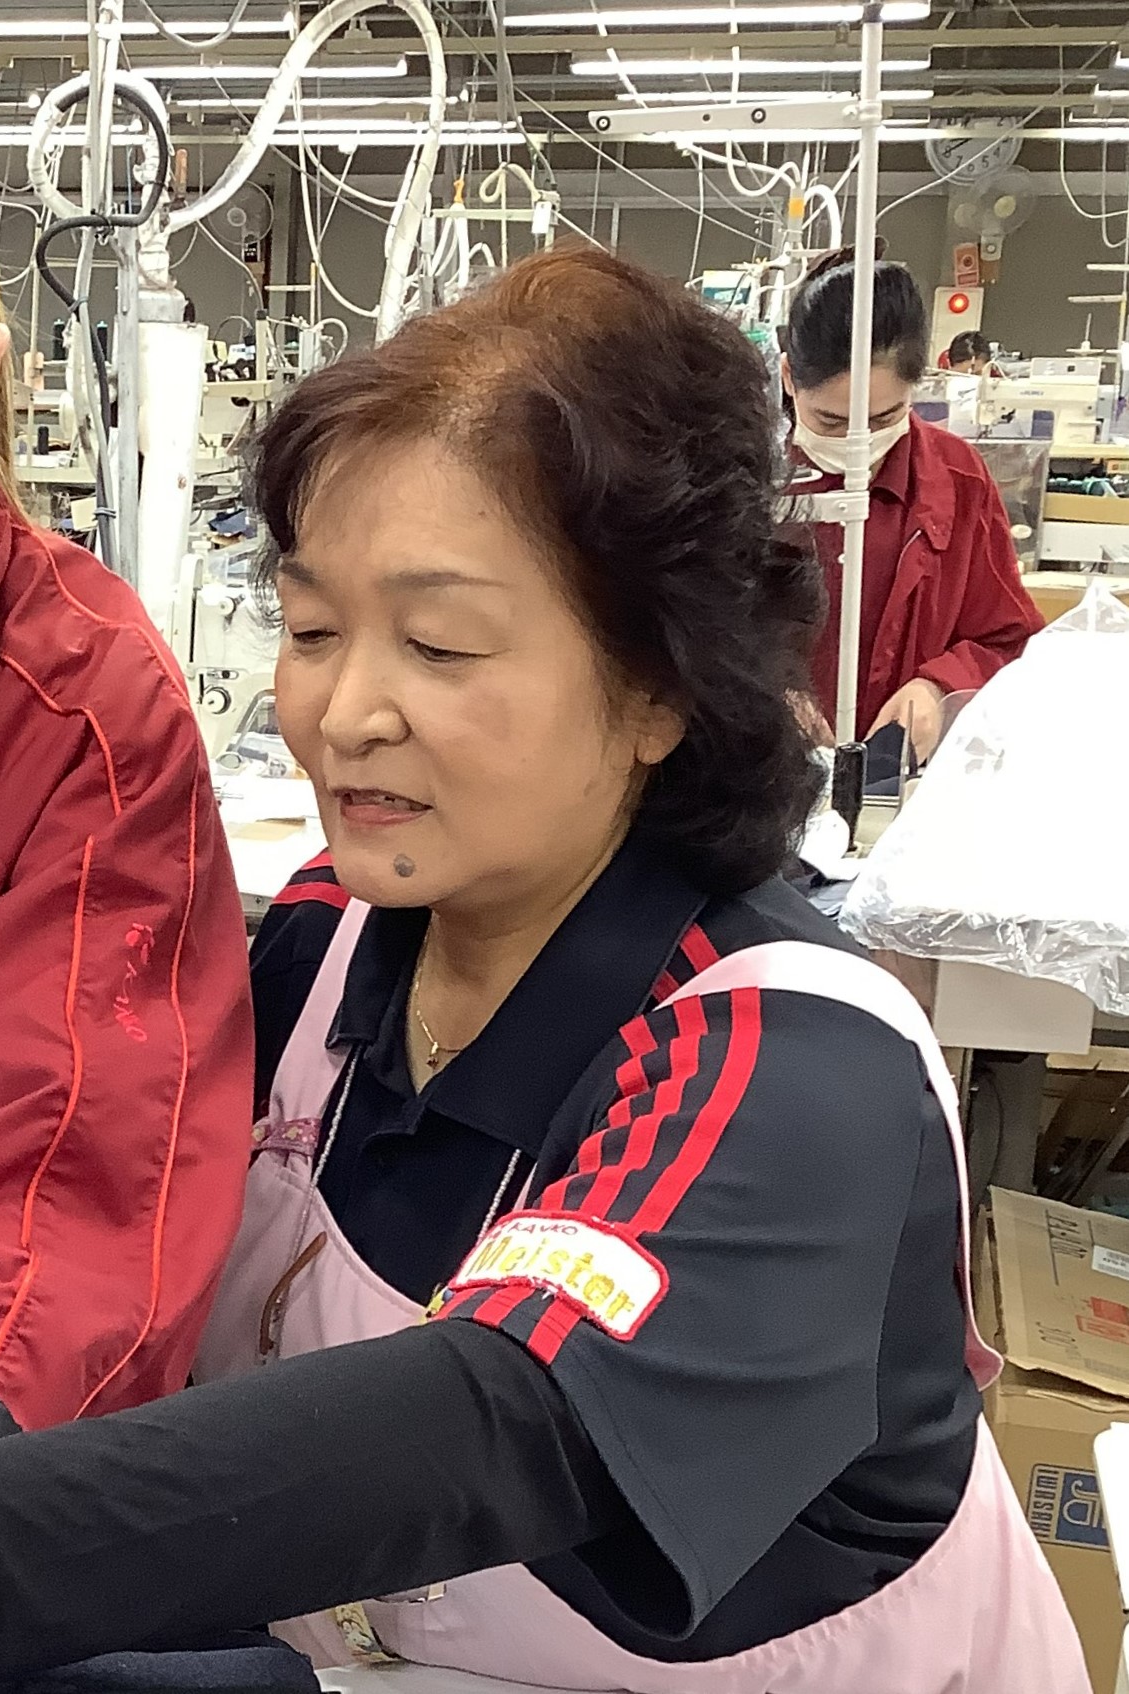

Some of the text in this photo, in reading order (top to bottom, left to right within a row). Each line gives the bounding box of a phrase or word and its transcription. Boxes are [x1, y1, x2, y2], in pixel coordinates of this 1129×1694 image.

[956, 155, 963, 169] 7
[982, 155, 989, 168] 5
[465, 1236, 636, 1320] Meister
